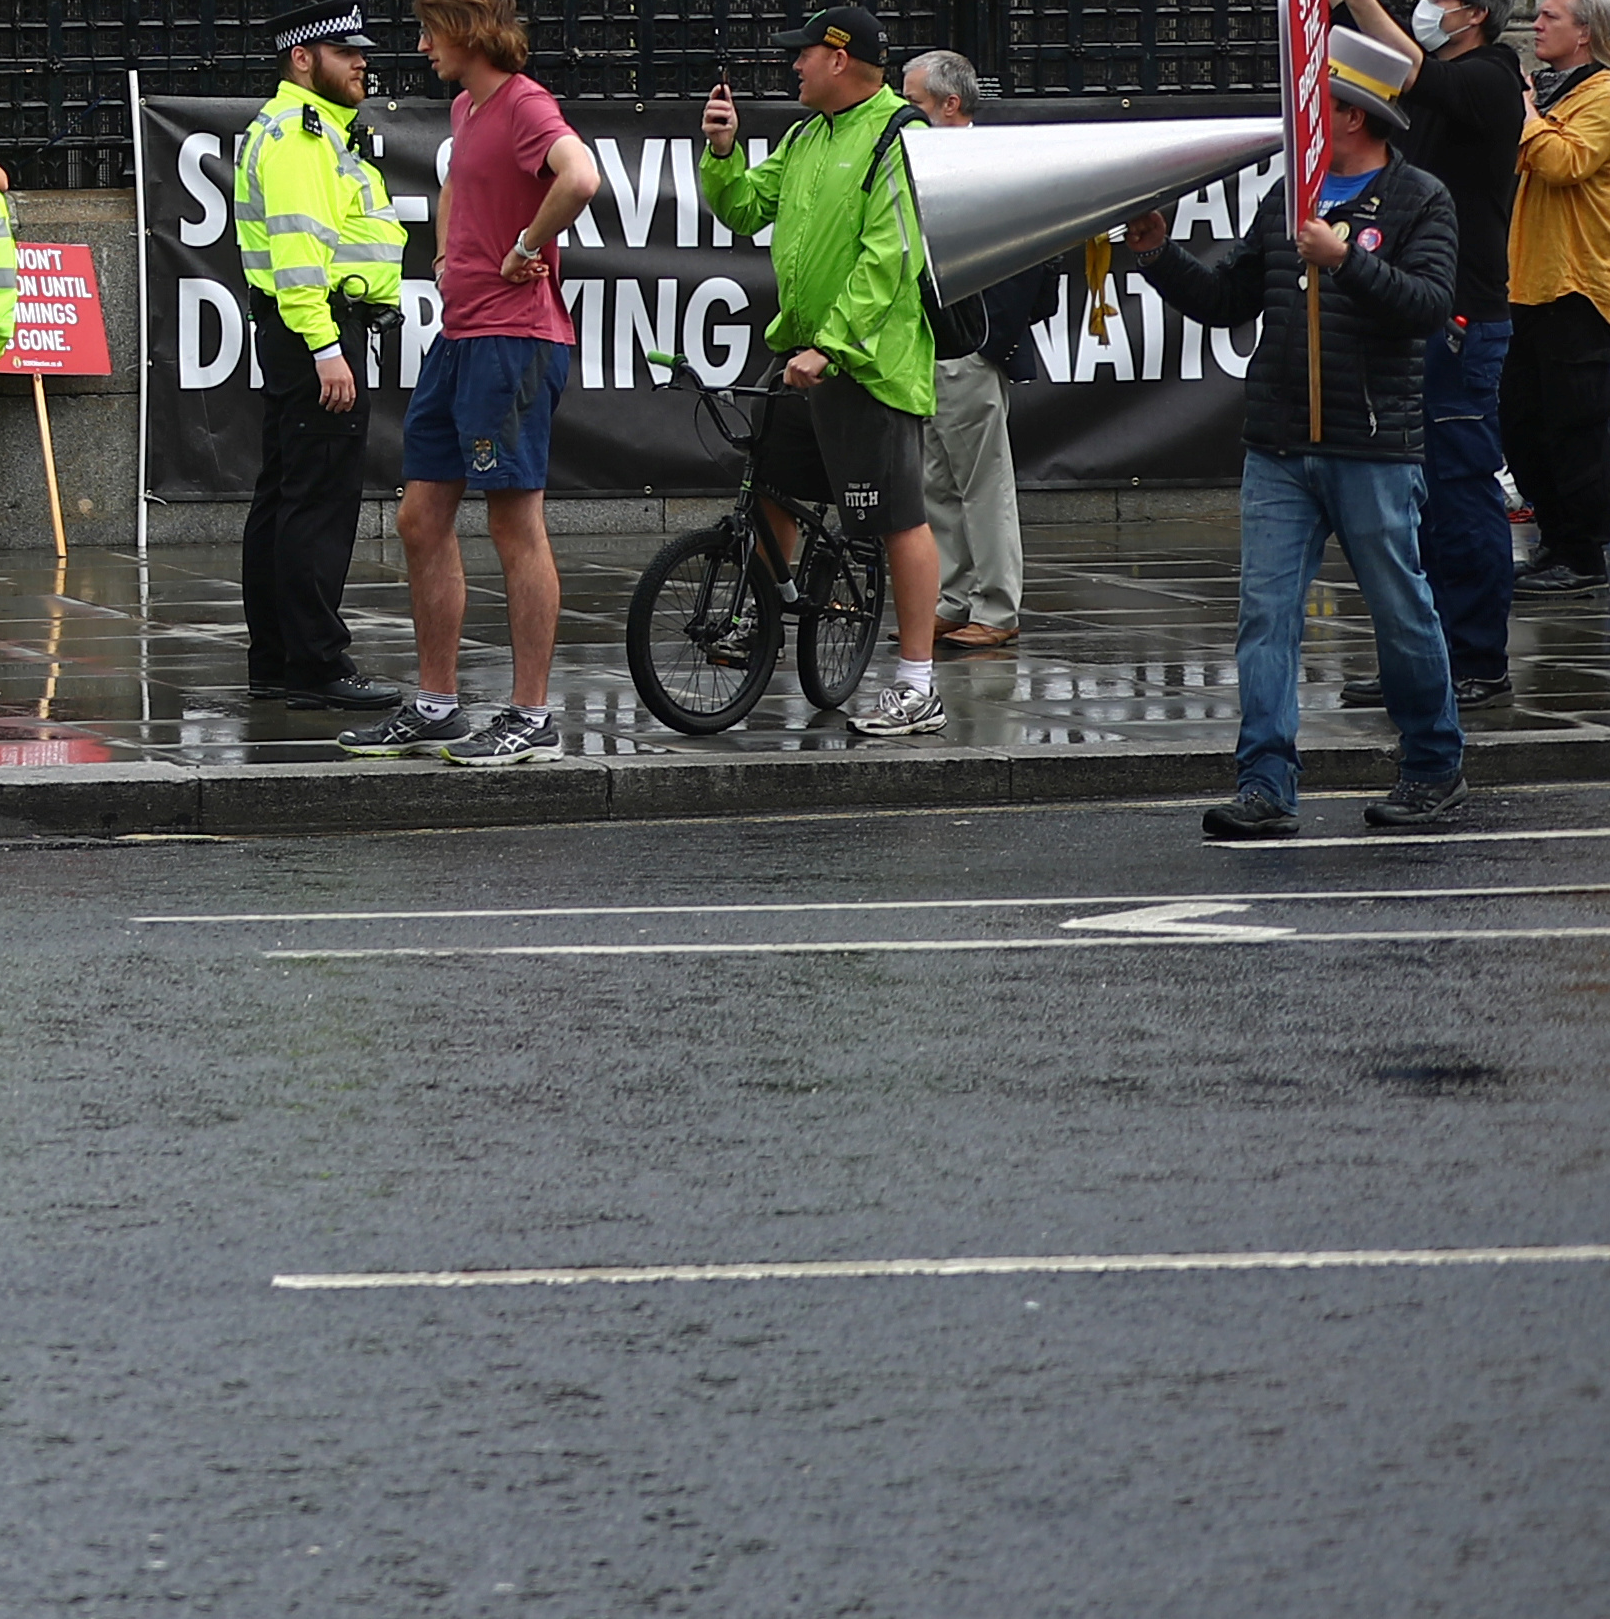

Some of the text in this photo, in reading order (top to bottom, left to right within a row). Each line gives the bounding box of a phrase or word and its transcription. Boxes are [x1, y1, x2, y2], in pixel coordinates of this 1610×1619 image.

[1298, 22, 1326, 112] BREXIT
[1308, 83, 1320, 136] NO
[1304, 118, 1325, 185] DEAL
[40, 276, 93, 298] UNTIL
[17, 328, 72, 351] GONE.
